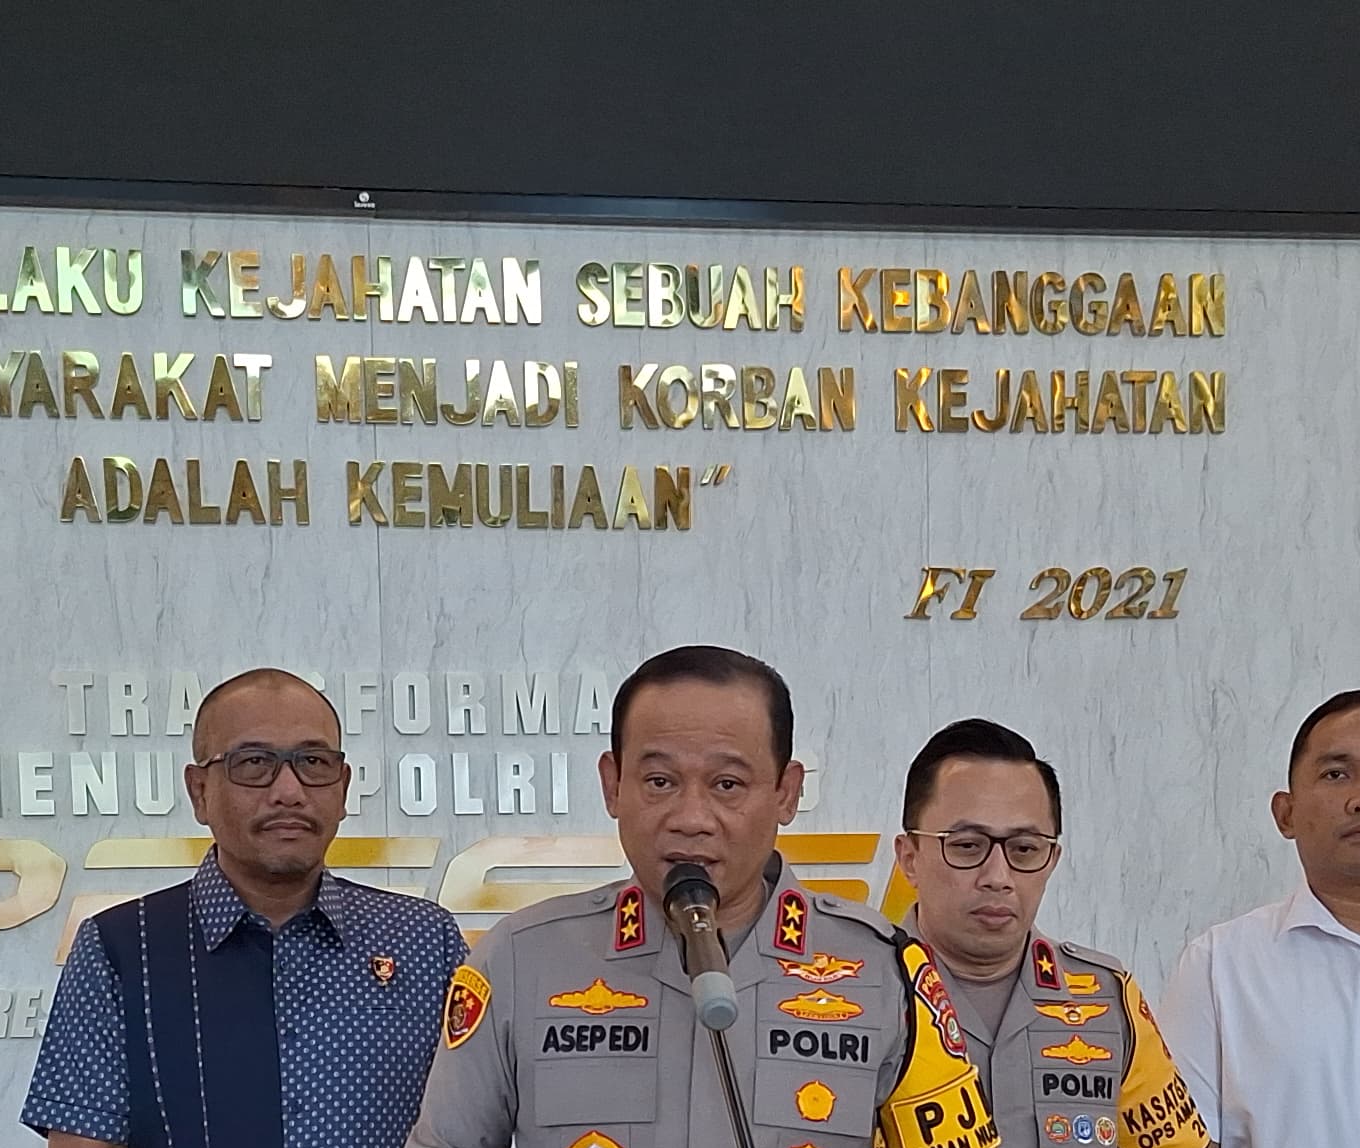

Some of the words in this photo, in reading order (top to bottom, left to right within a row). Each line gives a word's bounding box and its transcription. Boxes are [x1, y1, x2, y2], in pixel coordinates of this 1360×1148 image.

[180, 248, 543, 325] KEJAHATAN
[576, 260, 805, 332] SEBUAH
[838, 266, 1227, 338] KEBANGGAAN
[315, 354, 580, 428] MENJADI
[618, 362, 857, 433] KORBAN
[894, 367, 1227, 436] KEJAHATAN
[60, 455, 310, 526] ADALAH
[905, 566, 996, 622] FI
[1019, 566, 1191, 622] 2021
[345, 750, 570, 816] POLRI
[770, 1029, 870, 1063] POLRI
[1042, 1073, 1113, 1100] POLRI
